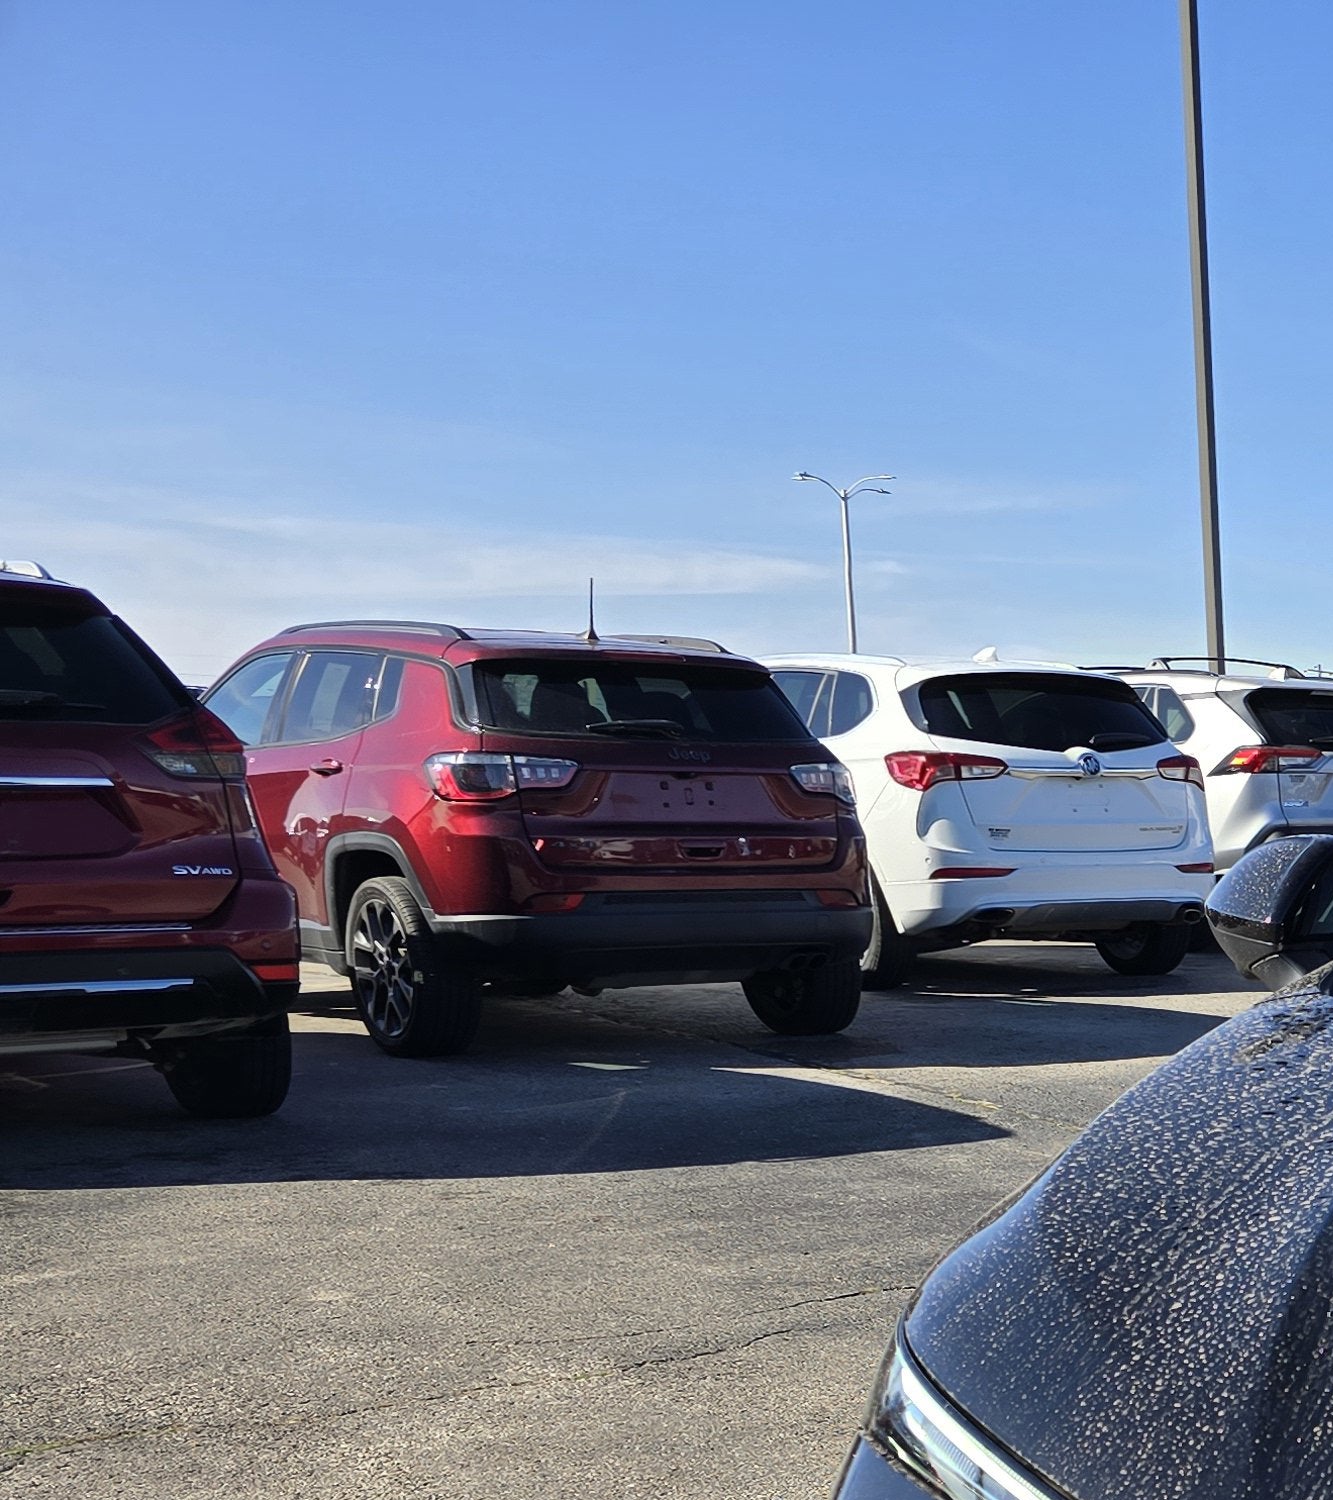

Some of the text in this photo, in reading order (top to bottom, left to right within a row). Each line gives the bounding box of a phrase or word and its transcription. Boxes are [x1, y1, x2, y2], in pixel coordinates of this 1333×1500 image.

[668, 746, 711, 763] Jeep
[172, 865, 233, 875] SV AWD
